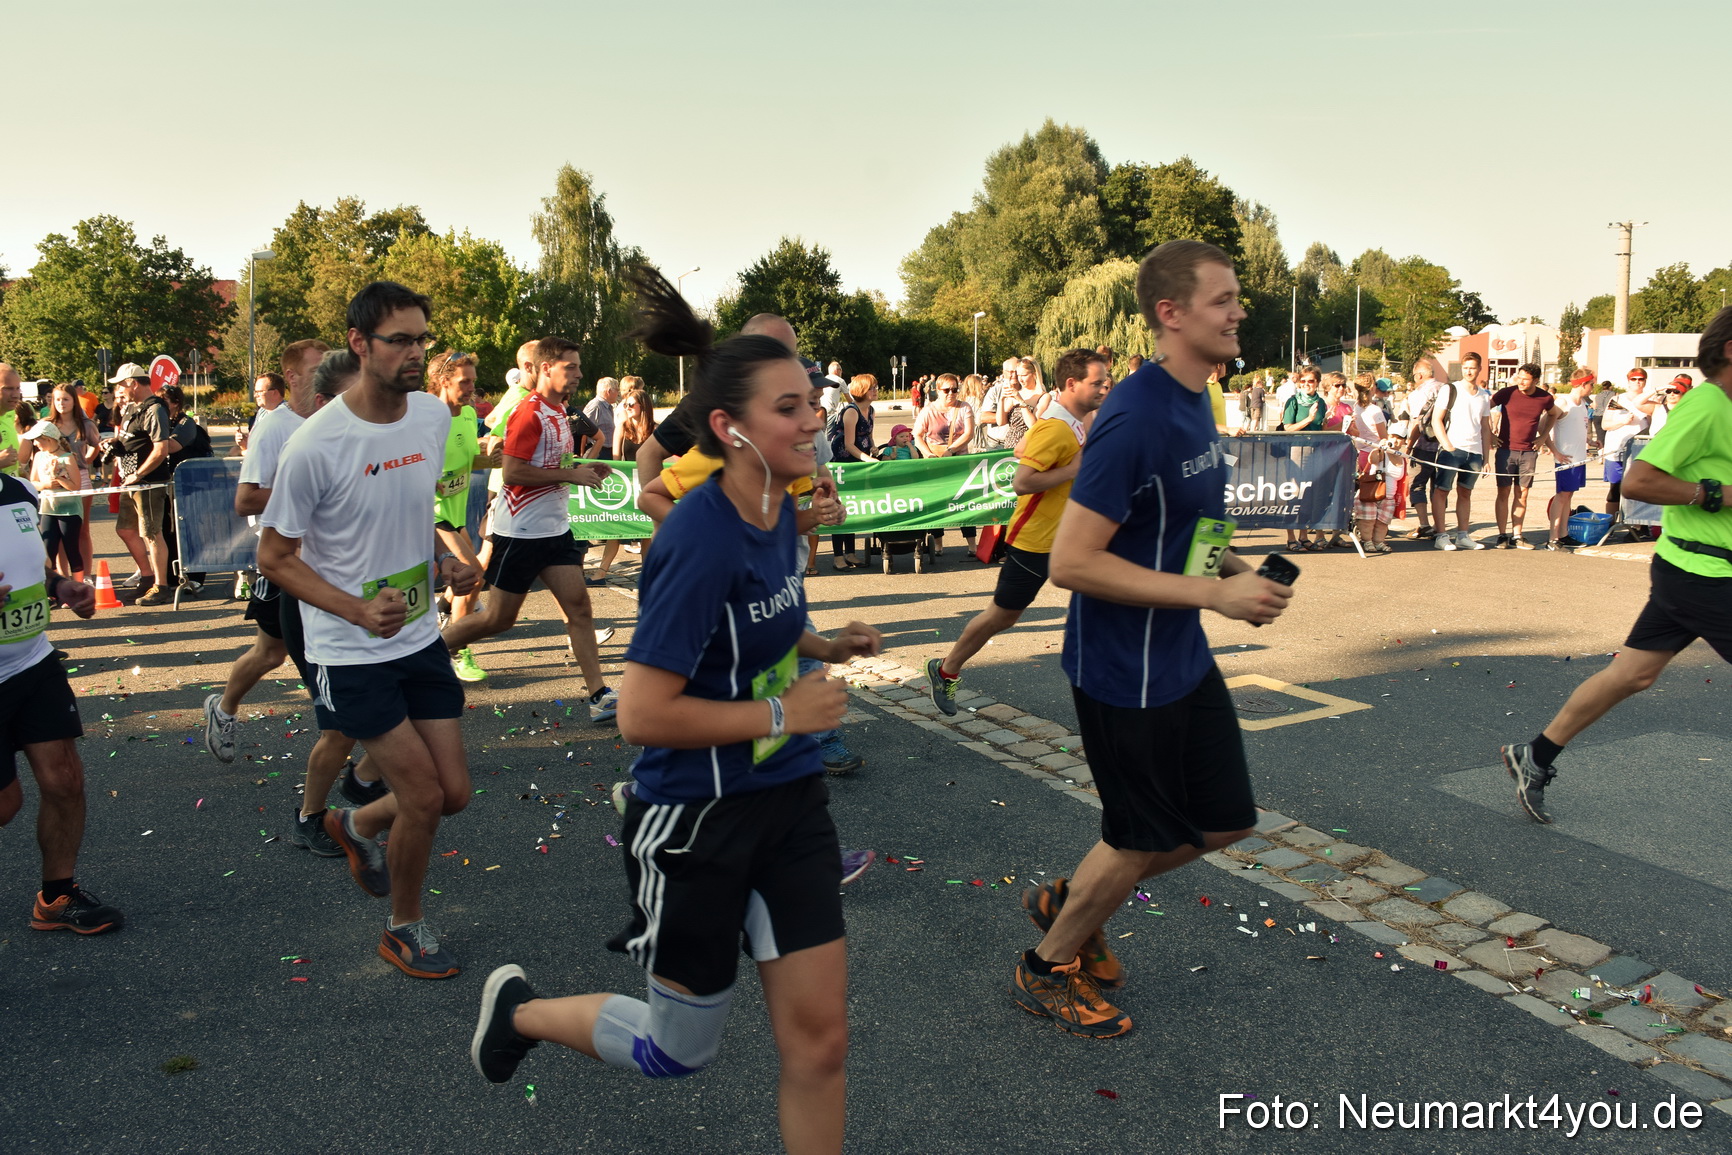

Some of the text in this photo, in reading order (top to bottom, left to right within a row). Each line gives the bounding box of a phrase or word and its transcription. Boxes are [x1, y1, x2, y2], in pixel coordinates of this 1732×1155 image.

[383, 453, 426, 471] KLEBL
[839, 493, 924, 516] änden
[948, 502, 966, 512] Die
[0, 602, 44, 630] 1372
